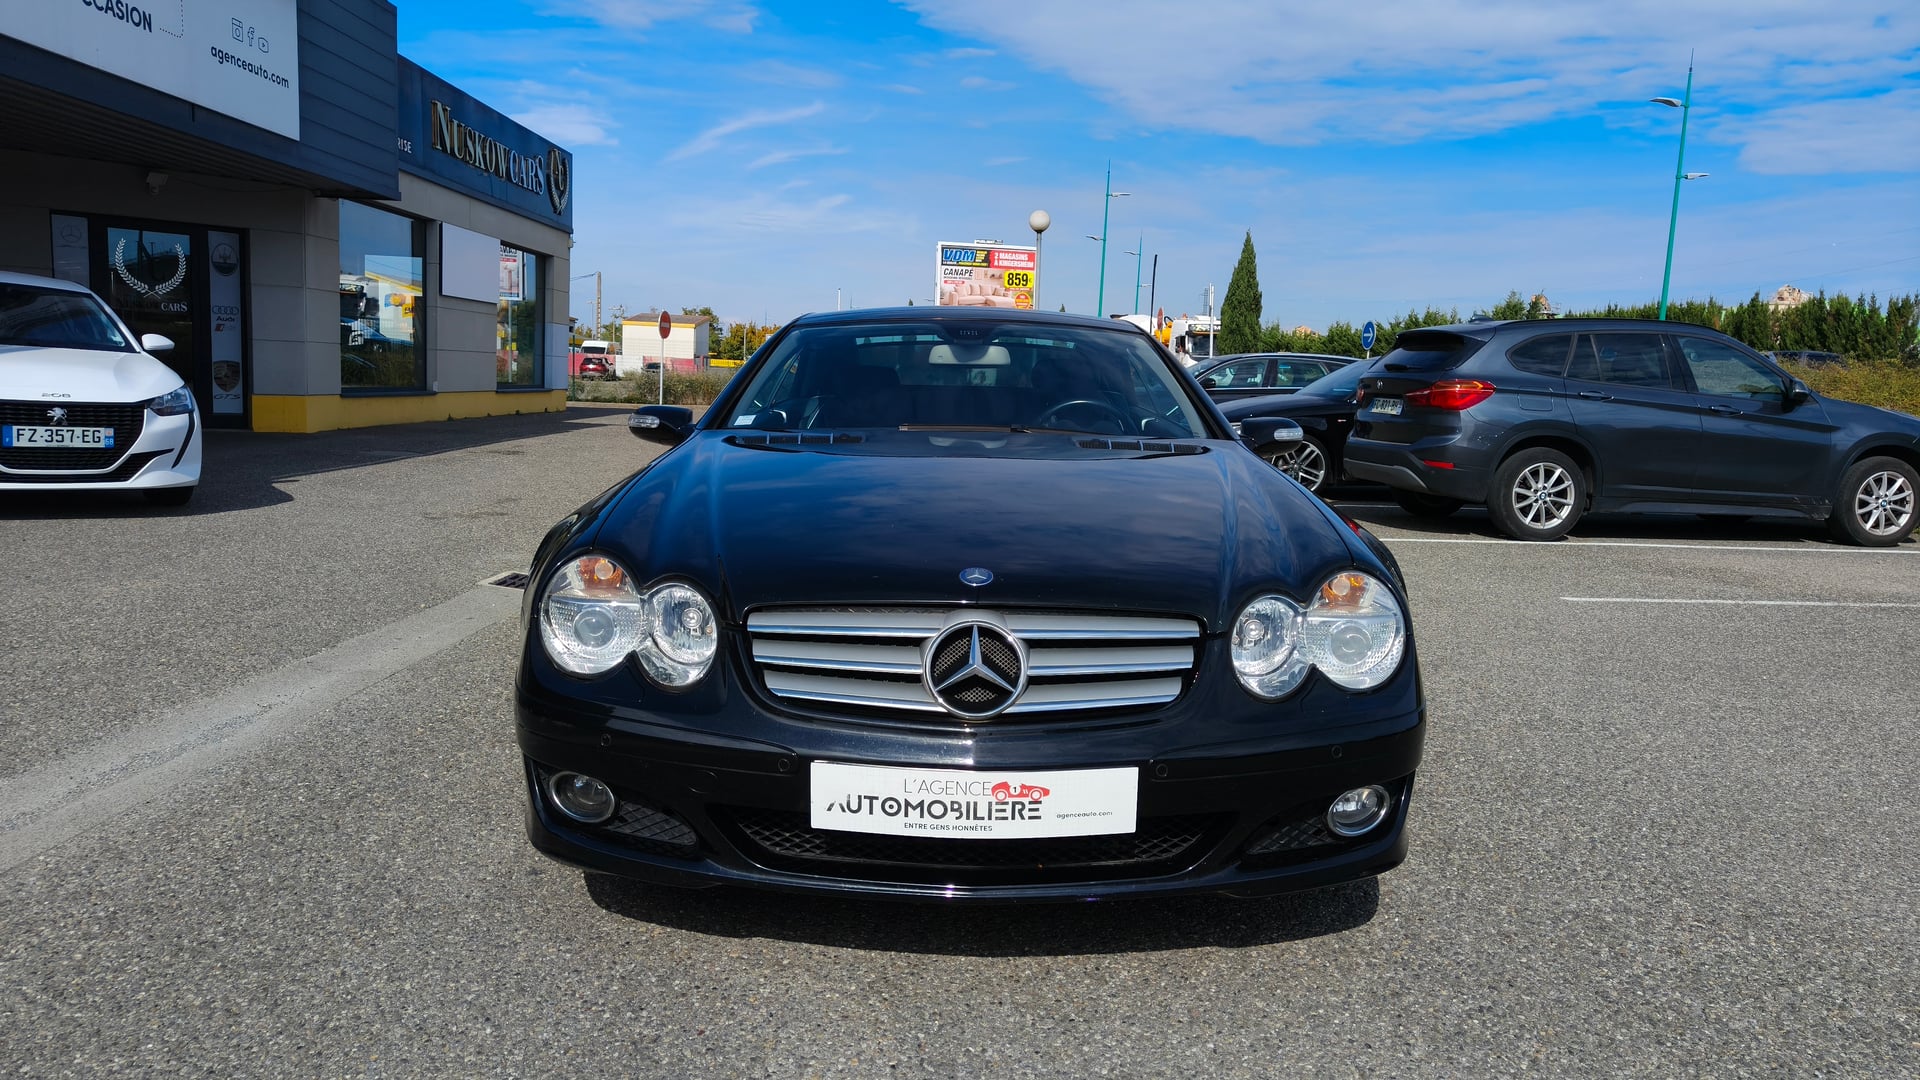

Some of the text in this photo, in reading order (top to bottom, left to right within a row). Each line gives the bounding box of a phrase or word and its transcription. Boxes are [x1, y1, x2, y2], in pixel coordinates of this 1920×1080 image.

[210, 45, 289, 89] agenceauto.com
[943, 249, 975, 262] VDM
[999, 252, 1028, 260] MAGASINS
[161, 301, 188, 313] CARS
[16, 428, 101, 443] FZ-357-EG
[904, 778, 993, 797] L'AGENCE
[1056, 811, 1112, 819] agenceauto.com
[904, 822, 993, 832] ENTRE GENS HONNÊTES
